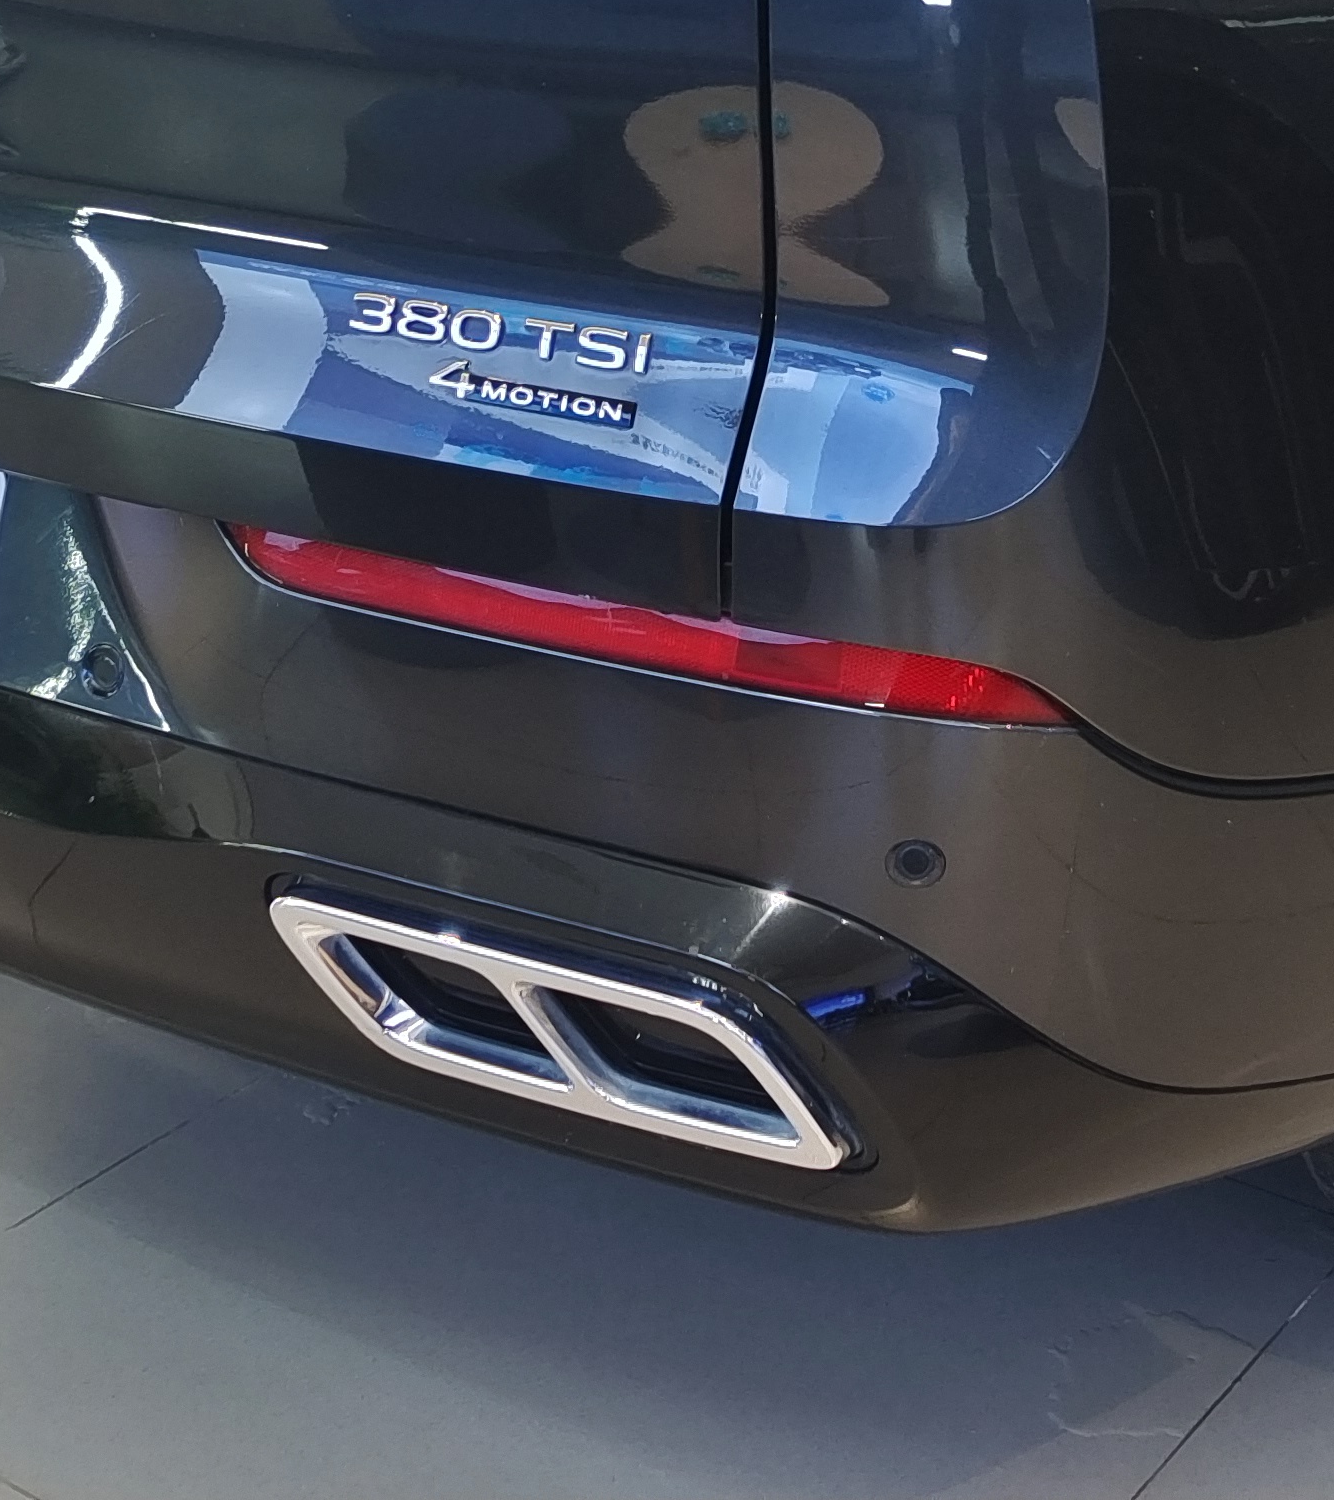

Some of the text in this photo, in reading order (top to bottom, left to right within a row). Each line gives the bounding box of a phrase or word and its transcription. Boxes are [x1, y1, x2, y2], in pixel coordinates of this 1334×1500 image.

[348, 291, 653, 375] 380 TSI
[428, 359, 624, 422] 4MOTION
